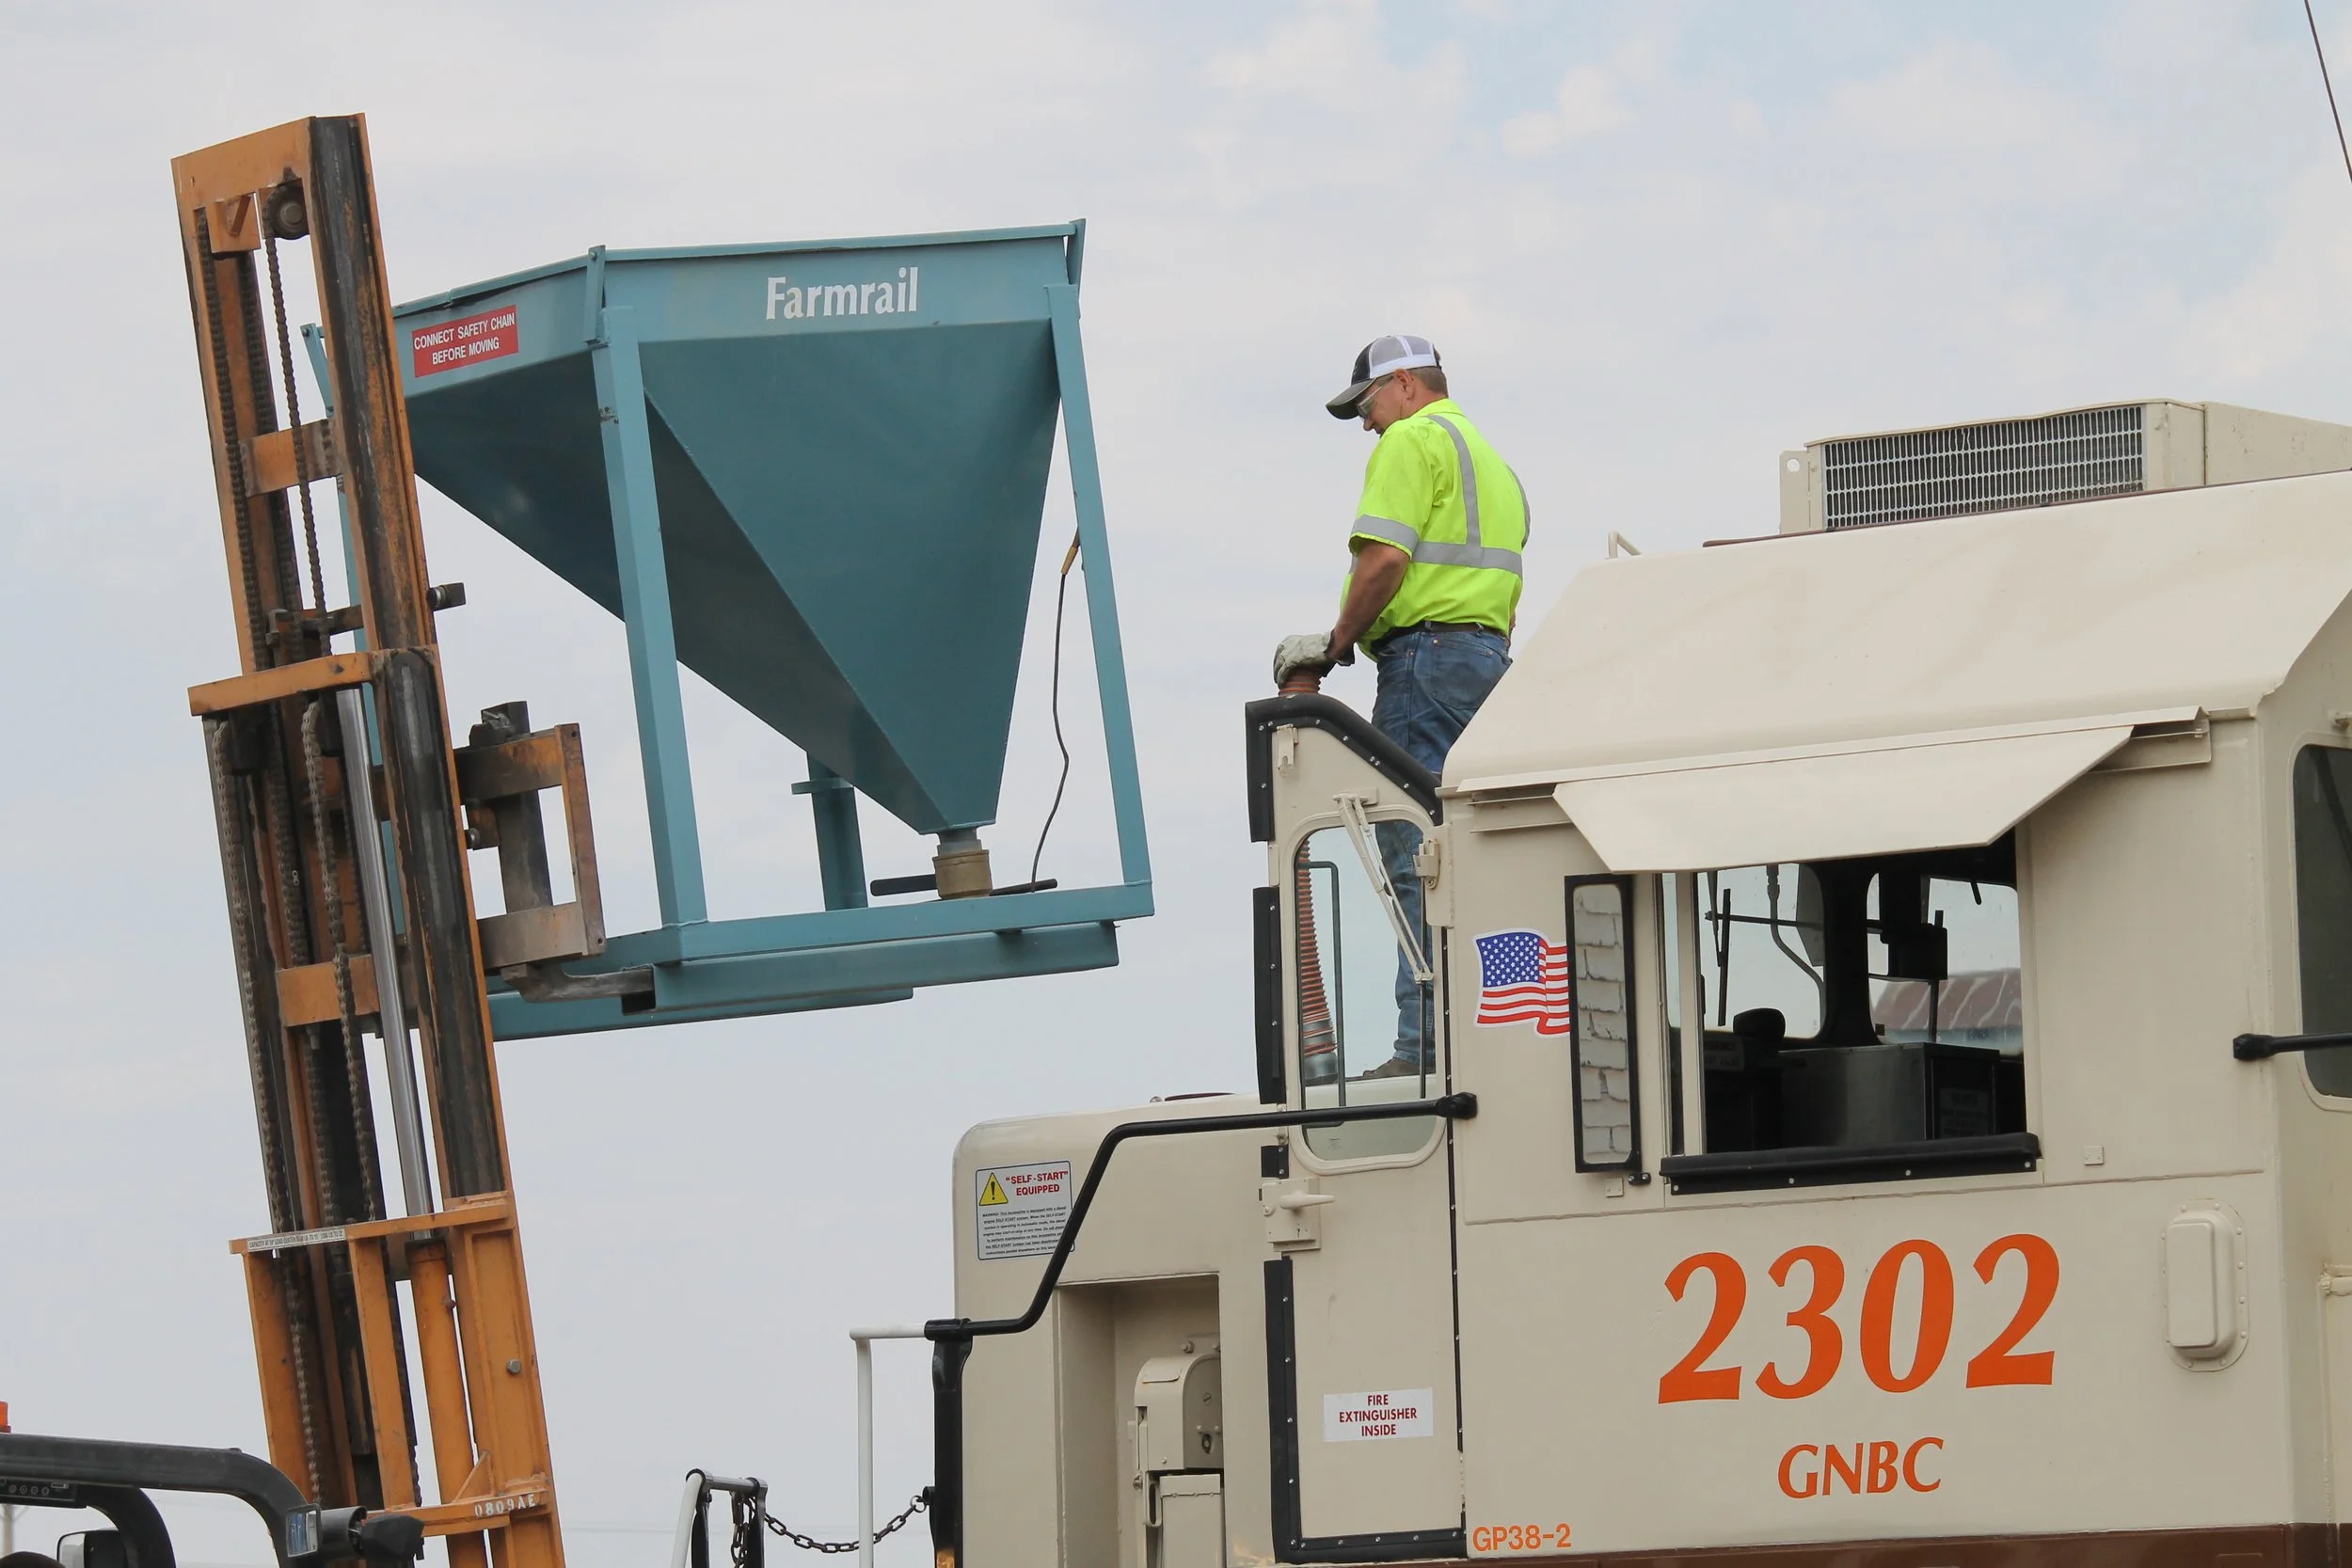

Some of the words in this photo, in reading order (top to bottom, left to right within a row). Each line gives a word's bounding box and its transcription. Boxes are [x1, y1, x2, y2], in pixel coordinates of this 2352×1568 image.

[766, 266, 918, 320] Farmrail
[414, 328, 454, 350] CONNECT
[457, 320, 488, 340] SAFETY
[490, 312, 516, 331] CHAIN
[432, 345, 467, 365] BEFORE
[469, 337, 500, 356] MOVING
[1016, 1184, 1059, 1196] EQUIPPED
[1658, 1233, 2059, 1404] 2302
[1367, 1394, 1389, 1406] FIRE
[1339, 1407, 1417, 1423] EXTINGUISHER
[1361, 1424, 1396, 1436] INSIDE
[1777, 1436, 1944, 1499] GNBC
[1472, 1523, 1571, 1551] GP38-2
